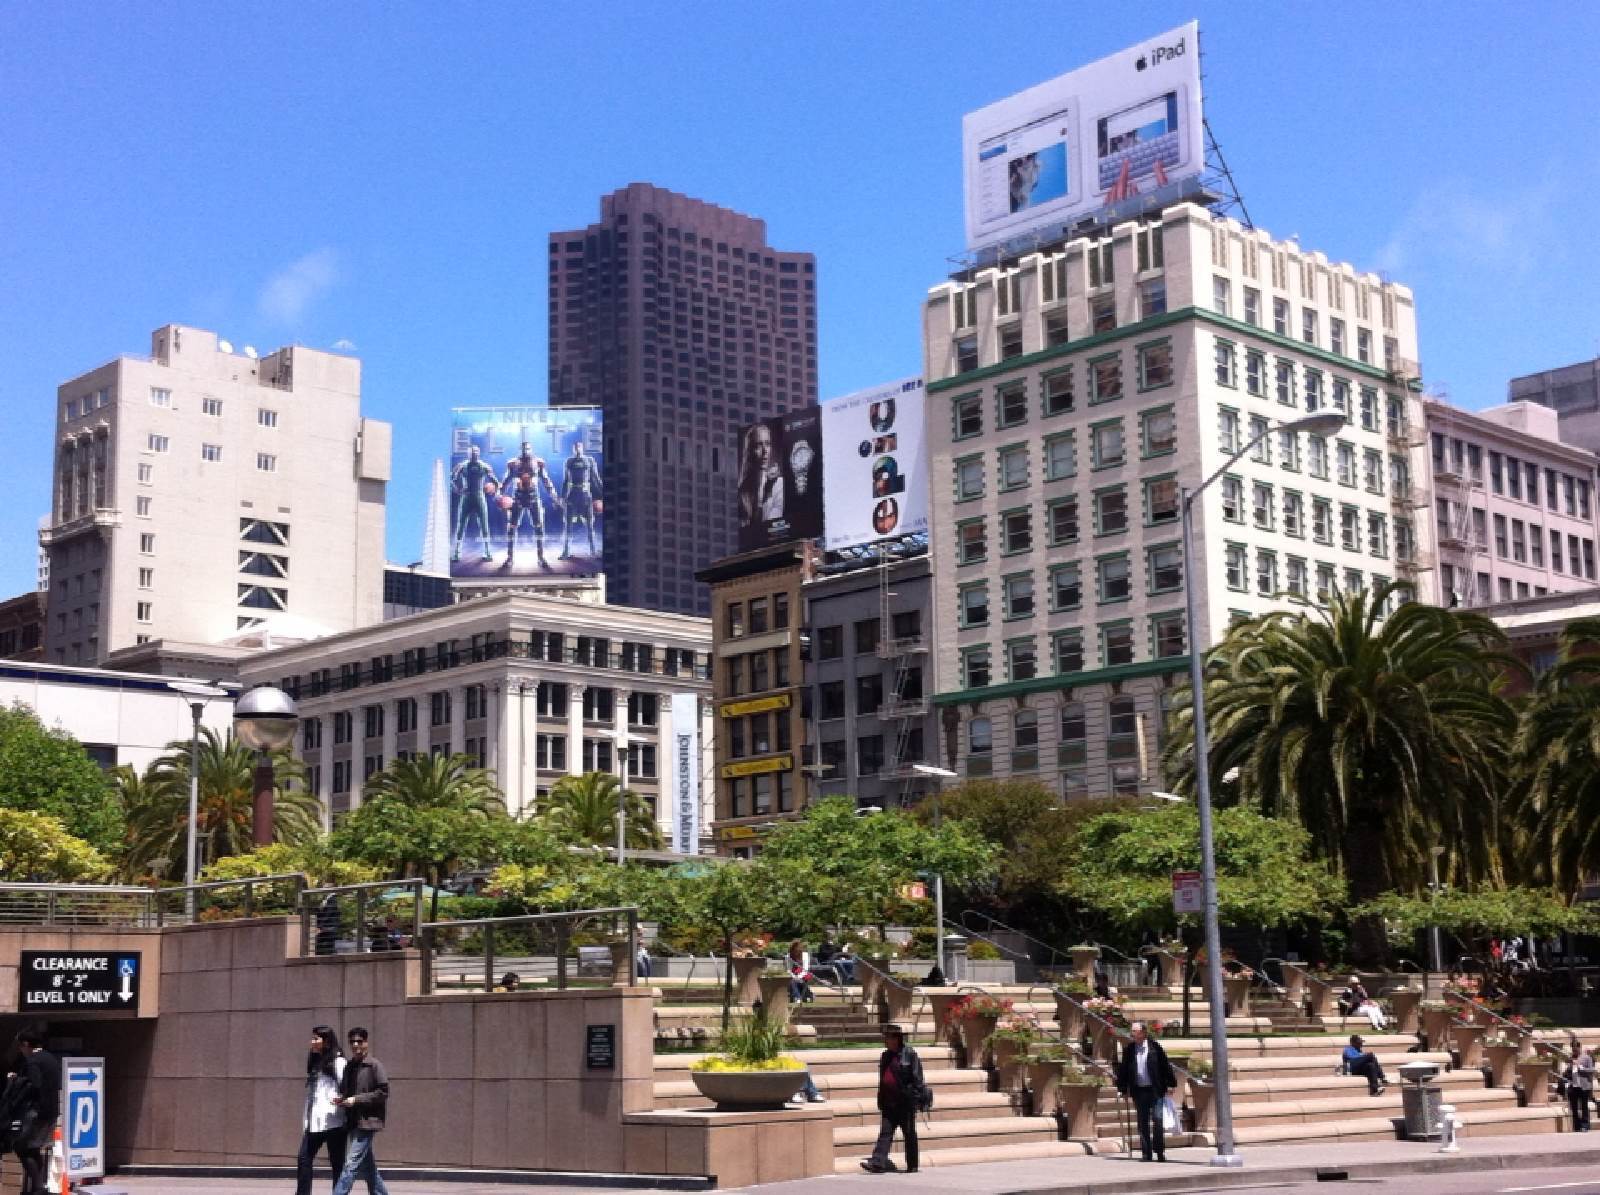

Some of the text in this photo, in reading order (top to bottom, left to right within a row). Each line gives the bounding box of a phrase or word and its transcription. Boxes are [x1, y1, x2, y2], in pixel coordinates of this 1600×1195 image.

[1152, 37, 1185, 66] iPad
[502, 410, 547, 424] NIKE
[453, 423, 603, 453] ELITE
[32, 957, 108, 971] CLEARANCE
[27, 991, 112, 1004] LEVEL 1 ONLY
